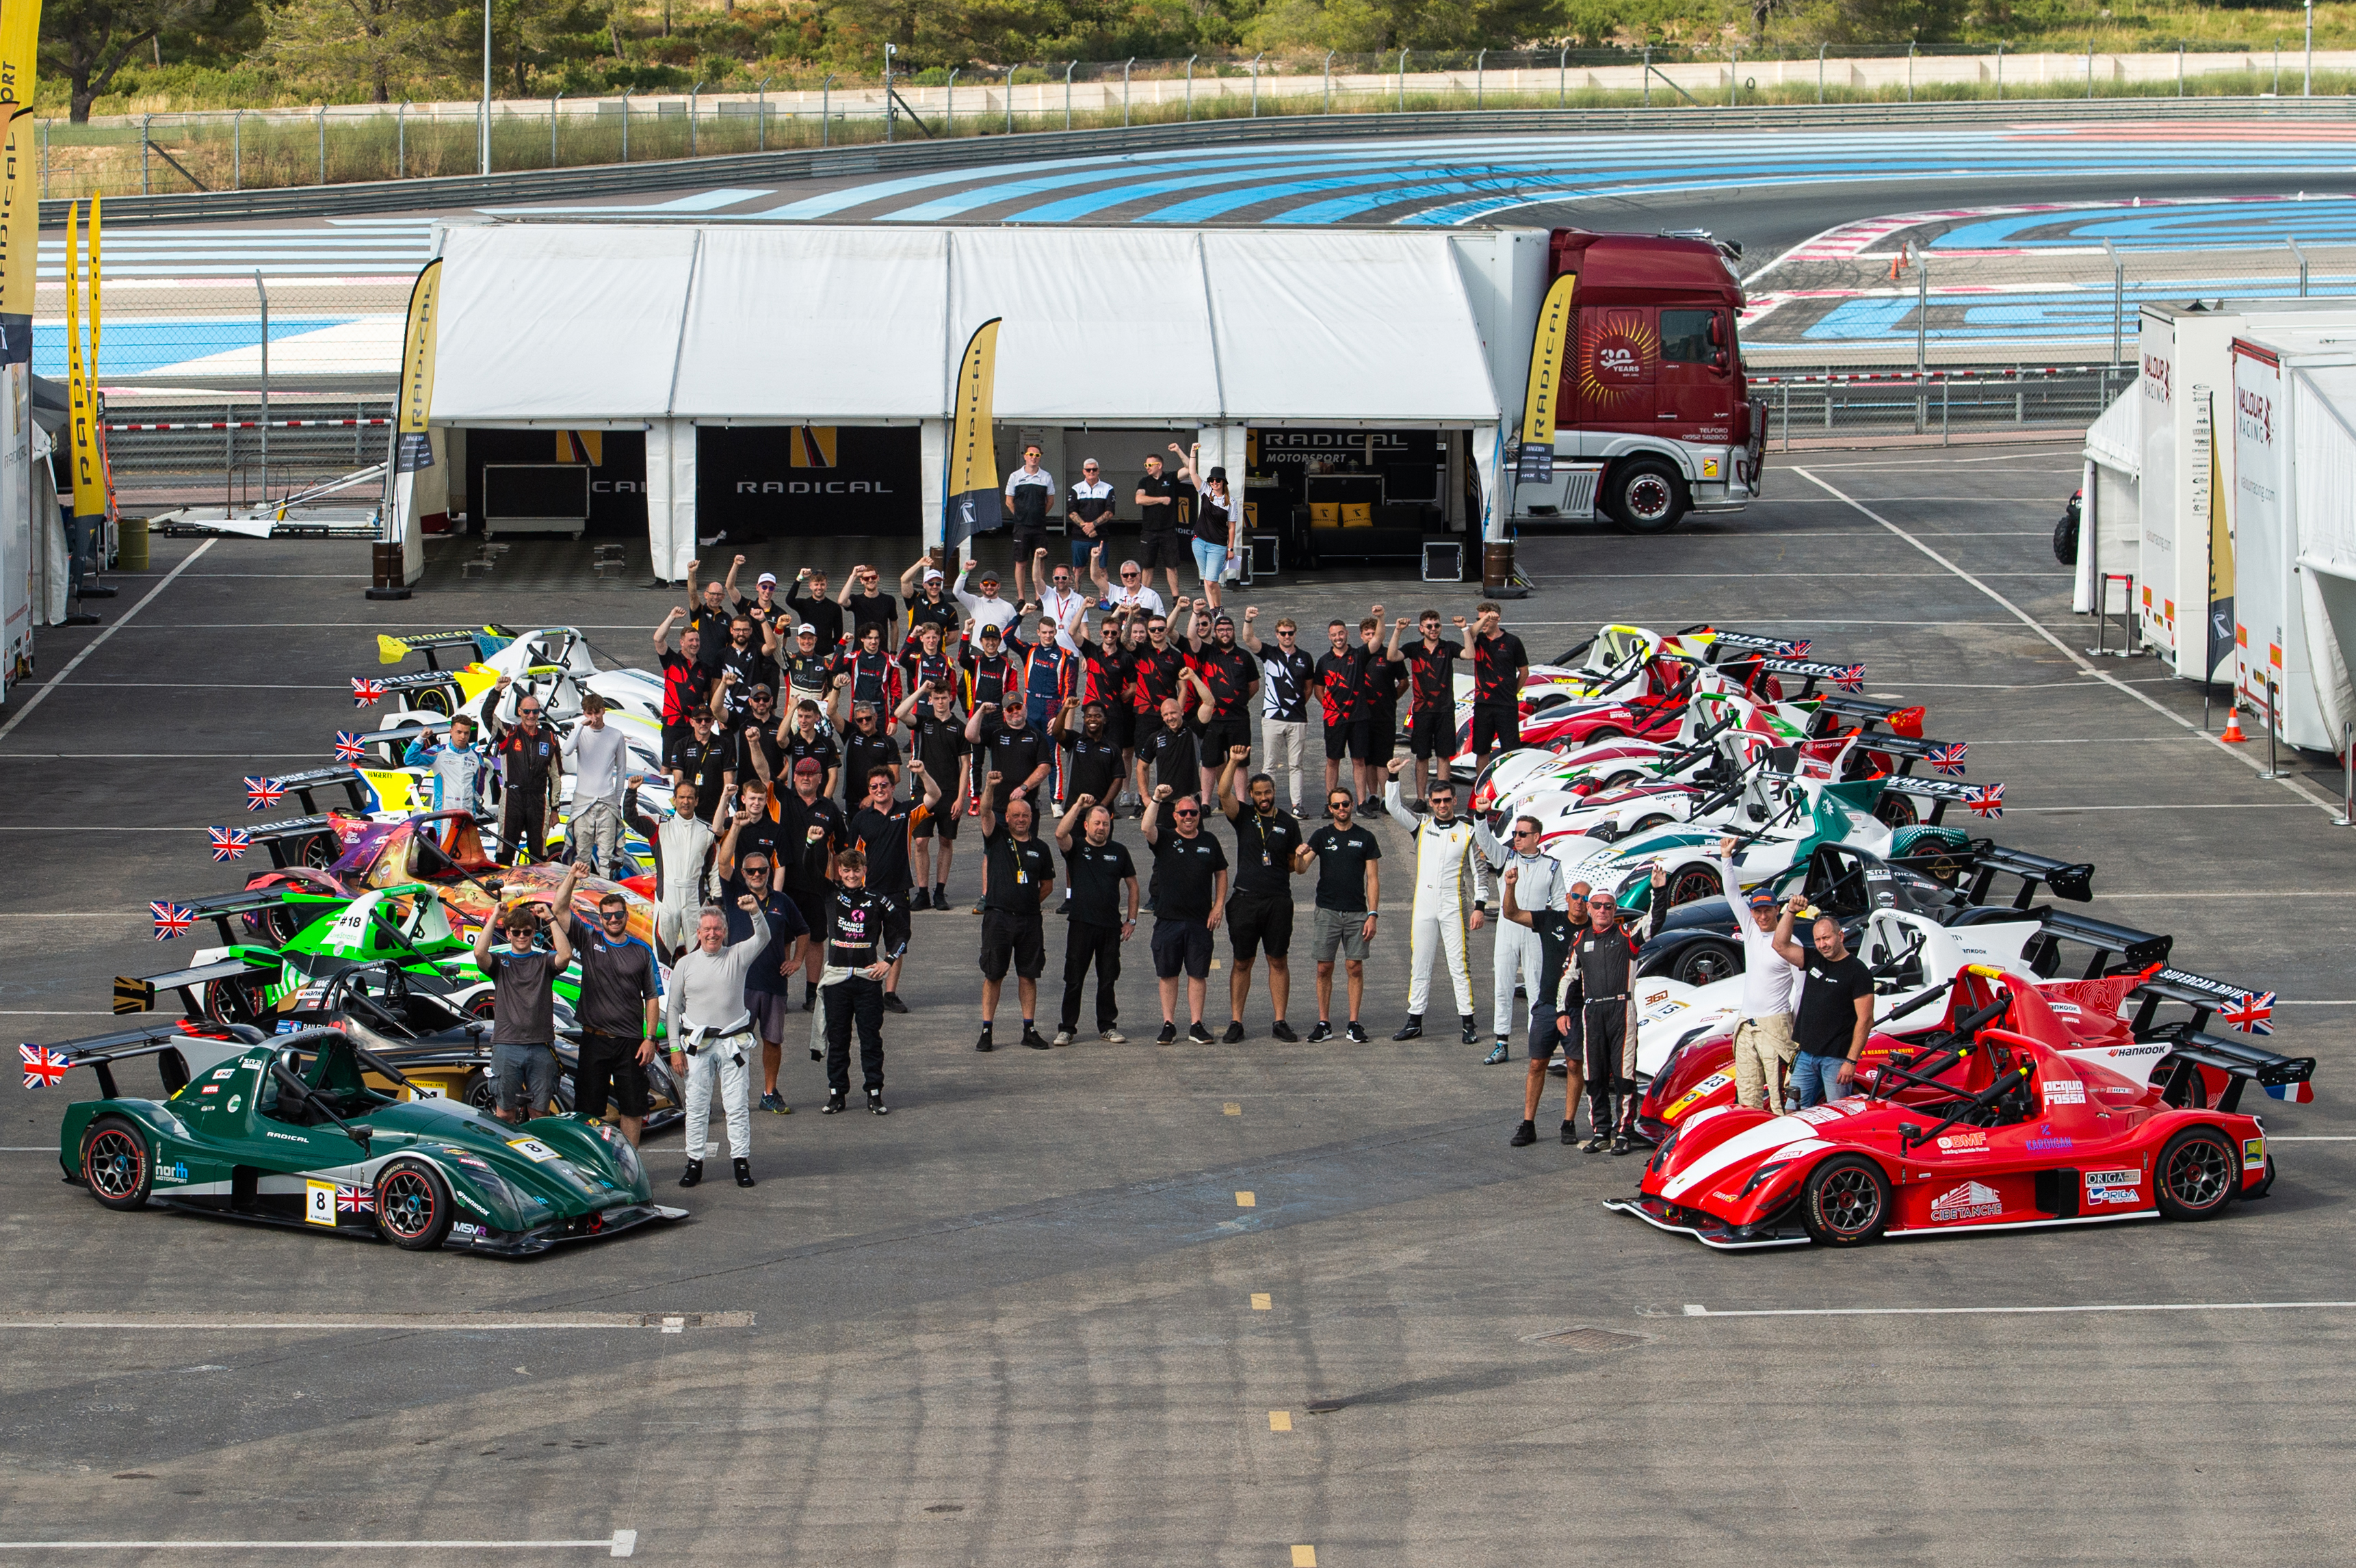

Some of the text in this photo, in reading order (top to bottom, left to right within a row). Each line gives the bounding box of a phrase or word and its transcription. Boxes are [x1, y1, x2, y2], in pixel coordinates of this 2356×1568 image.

[413, 283, 432, 428] RADICAL
[1534, 293, 1562, 438] RADICAL
[2144, 352, 2164, 381] VALOUR
[2145, 380, 2164, 403] RACING
[2238, 386, 2263, 421] VALOUR
[2239, 416, 2264, 444] RACING
[1266, 434, 1409, 445] RADICAL
[1266, 454, 1347, 463] MOTORSPORT
[736, 481, 893, 494] RADICAL
[2240, 474, 2276, 502] valourracing.com
[368, 771, 393, 779] HAGERTY
[340, 915, 361, 928] #18
[837, 919, 865, 928] CHANGE
[329, 931, 357, 941] LiveStrata
[2161, 969, 2216, 993] SUPERCAR
[1645, 989, 1668, 1007] 360
[1658, 1004, 1680, 1015] 15
[2062, 1016, 2080, 1024] MOTUL
[1703, 1075, 1727, 1088] 23
[266, 1131, 310, 1144] RADICAL
[1950, 1132, 1987, 1148] BMF
[2025, 1137, 2073, 1151] KARDIGAN
[1772, 1150, 1801, 1160] MOTUL
[460, 1158, 487, 1168] MOTUL
[155, 1175, 188, 1184] MOTORSPORT
[2088, 1173, 2124, 1184] ORIGA
[2102, 1190, 2136, 1199] ORIGA
[316, 1192, 326, 1211] 8
[1930, 1203, 2002, 1221] CIBETANCHE
[453, 1221, 487, 1237] MSVR
